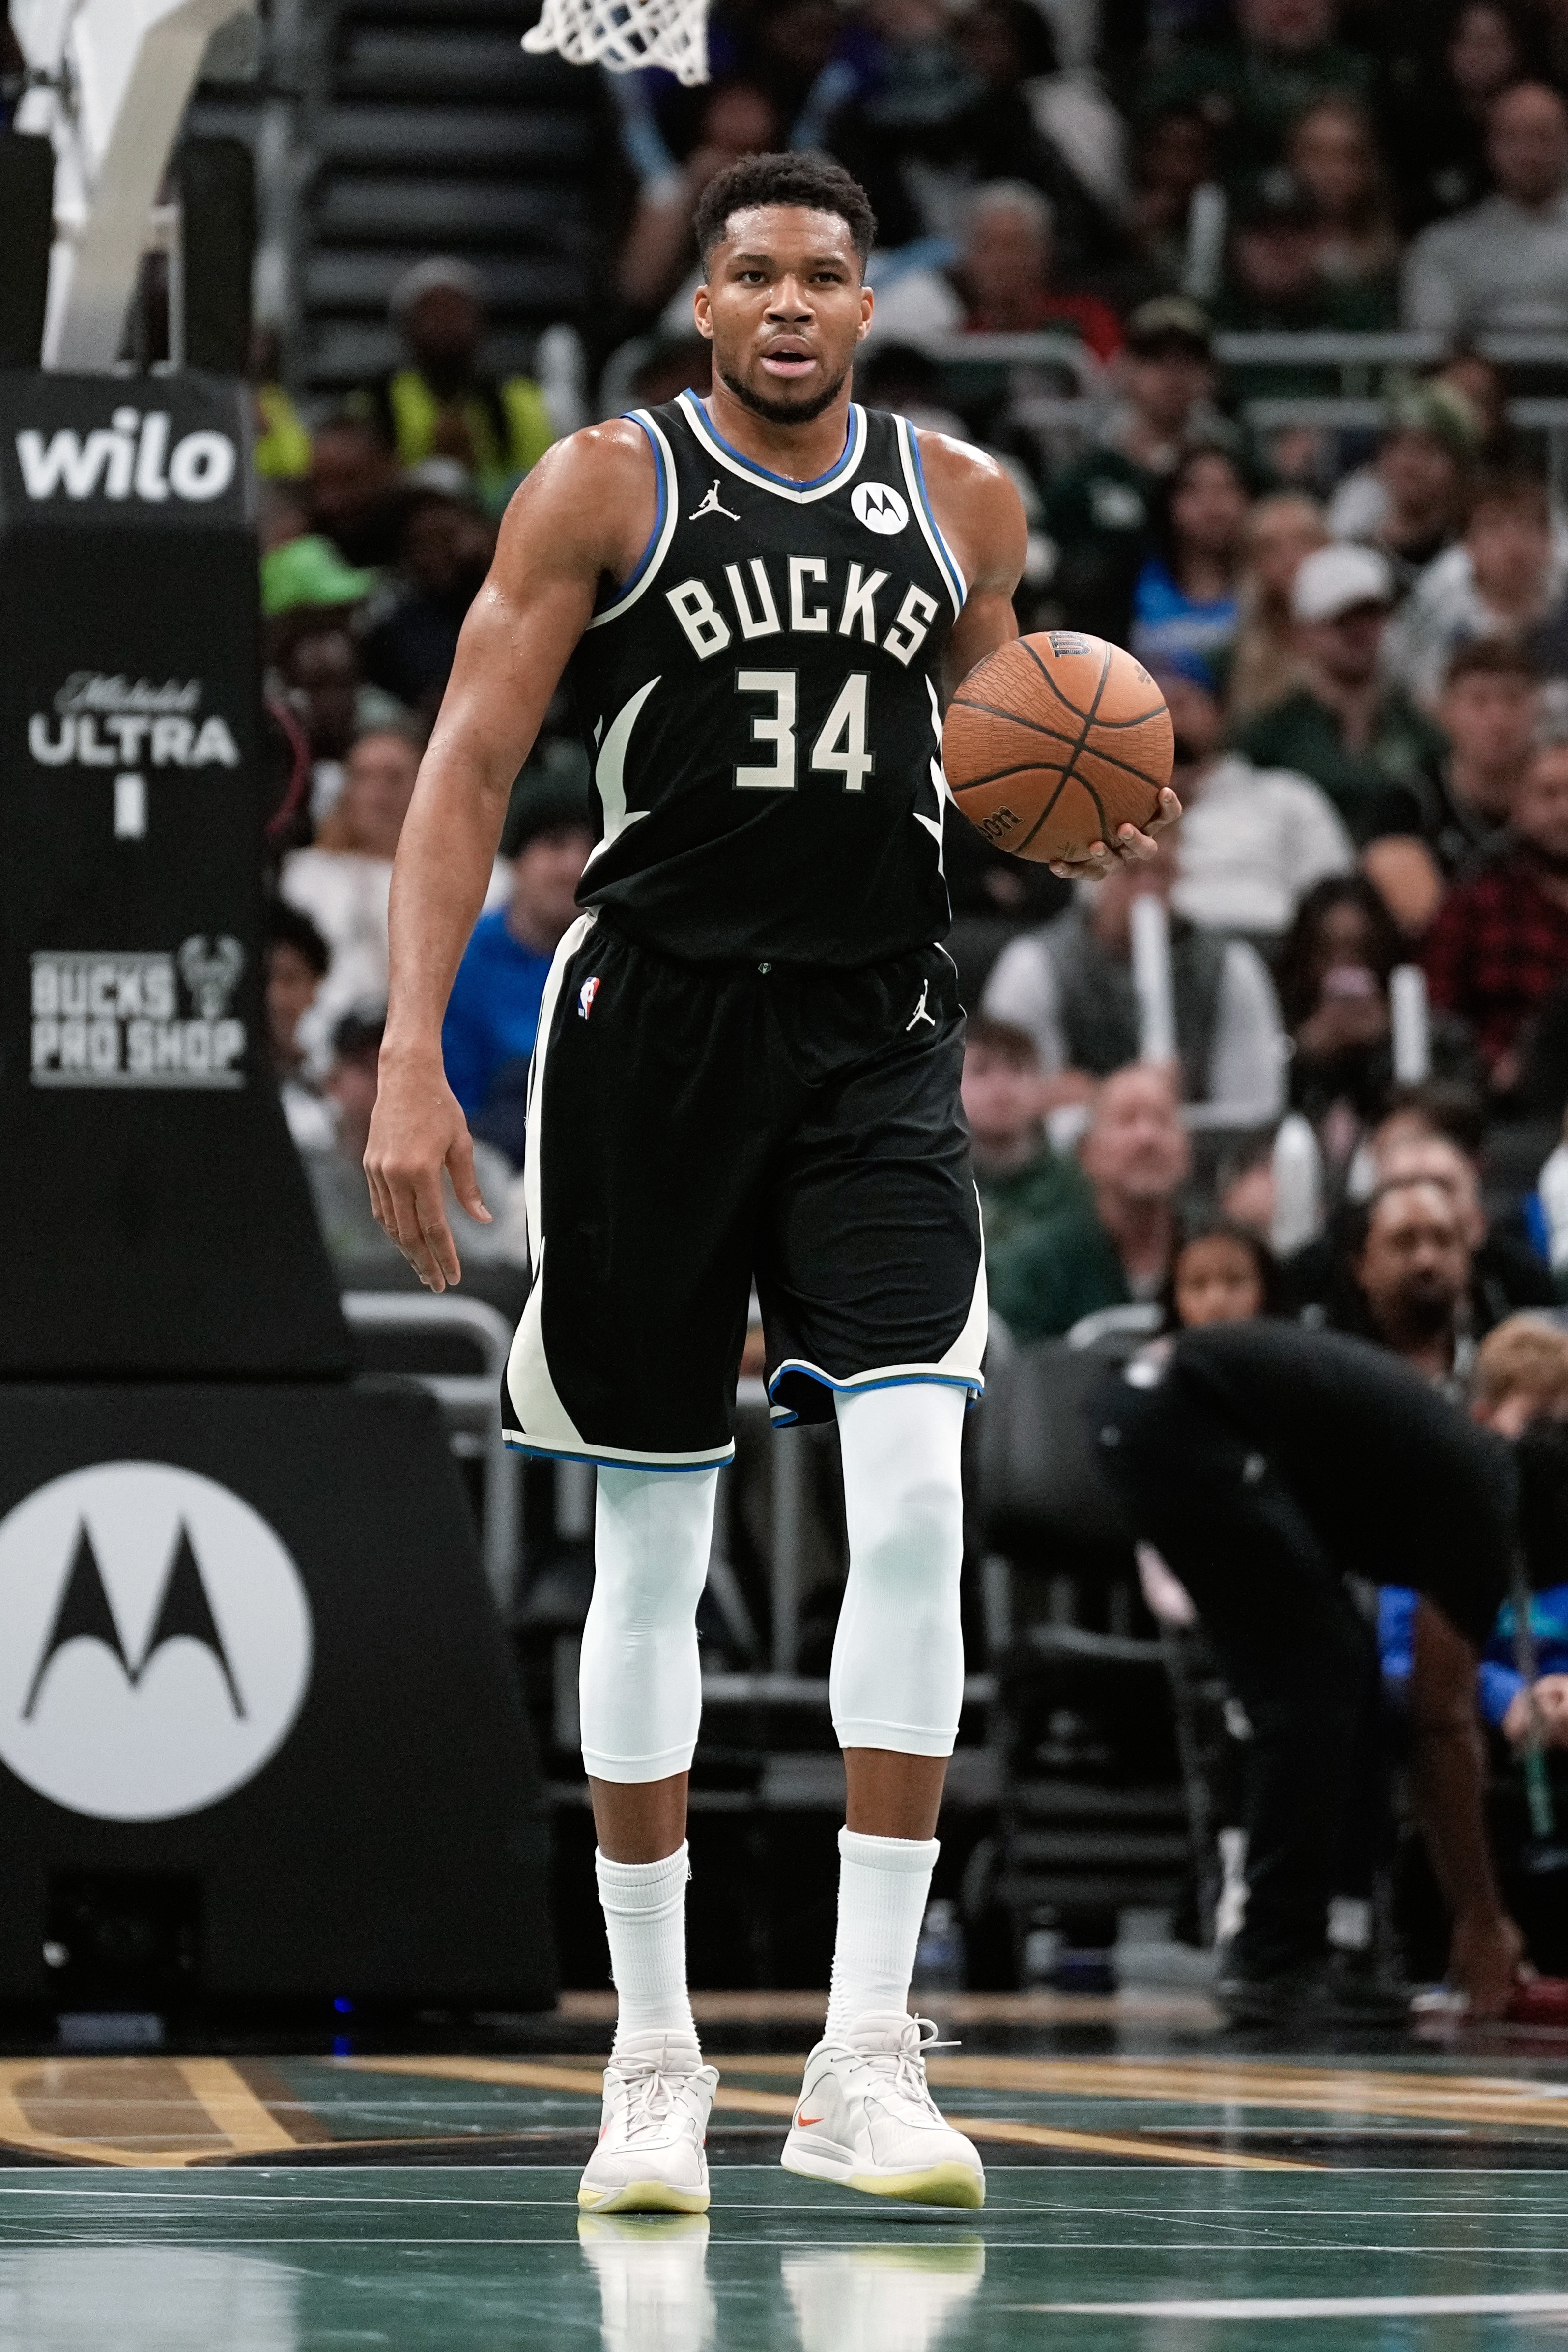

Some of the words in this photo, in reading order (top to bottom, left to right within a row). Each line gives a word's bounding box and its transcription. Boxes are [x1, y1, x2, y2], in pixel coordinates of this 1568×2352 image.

[16, 406, 237, 502] wilo
[665, 554, 940, 667] BUCKS
[29, 712, 241, 769] ULTRA
[732, 667, 876, 793] 34
